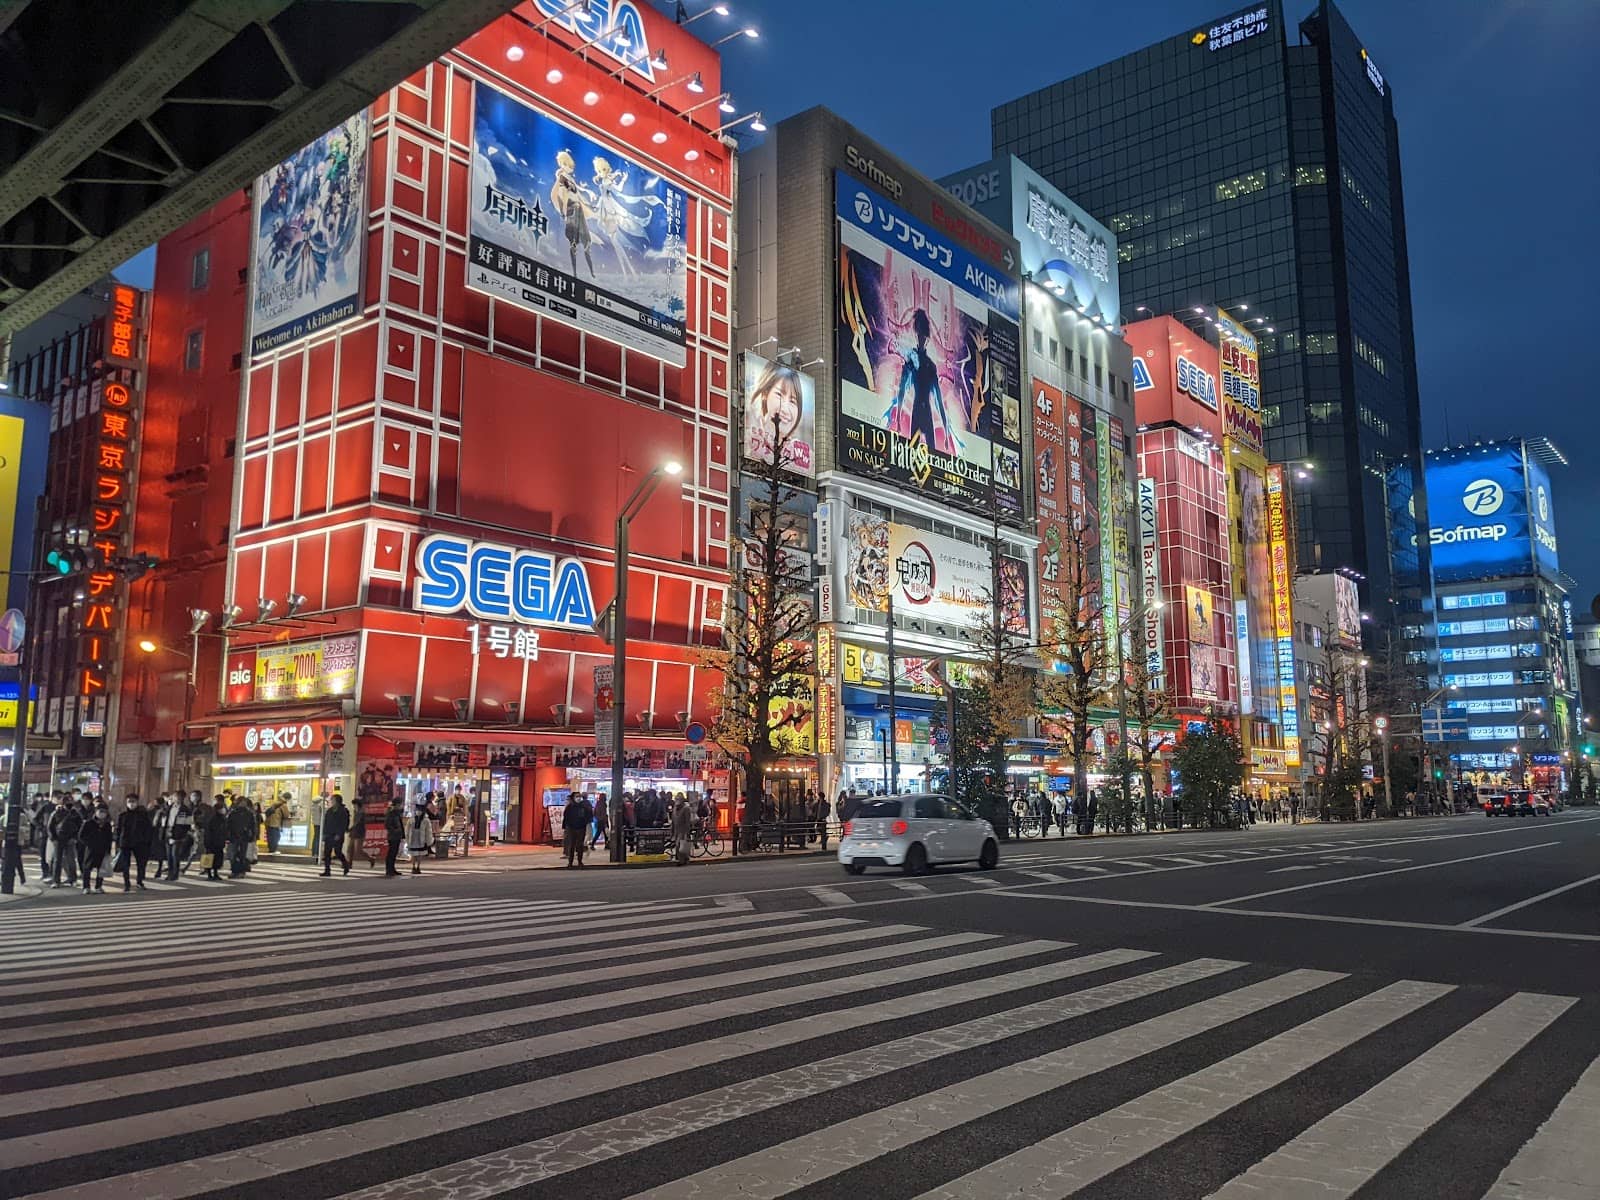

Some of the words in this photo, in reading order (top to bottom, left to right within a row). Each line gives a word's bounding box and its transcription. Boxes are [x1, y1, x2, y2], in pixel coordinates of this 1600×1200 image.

[1209, 8, 1268, 39] 住友不動産
[1209, 22, 1269, 51] 秋葉原ビル
[846, 146, 903, 199] Sofmap
[878, 207, 953, 268] ソフマップ
[964, 263, 1007, 303] AKIBA
[255, 330, 291, 350] Welcome
[294, 325, 303, 336] to
[305, 303, 355, 331] Akihabara
[1176, 355, 1218, 412] SEGA
[1036, 390, 1053, 417] 4F
[1036, 416, 1063, 435] カードゲーム
[848, 447, 863, 462] ON
[955, 457, 991, 487] Order
[1039, 467, 1055, 494] 3F
[1140, 483, 1154, 527] AKKY
[1429, 524, 1508, 545] Sofmap
[85, 412, 128, 694] 東京ラジオデパート
[414, 533, 598, 632] SEGA
[1042, 555, 1058, 582] 2F
[466, 623, 540, 661] 1号館
[1146, 609, 1159, 650] Shop
[229, 662, 251, 685] BIG
[846, 648, 860, 678] 5F
[259, 726, 297, 751] 宝くじ
